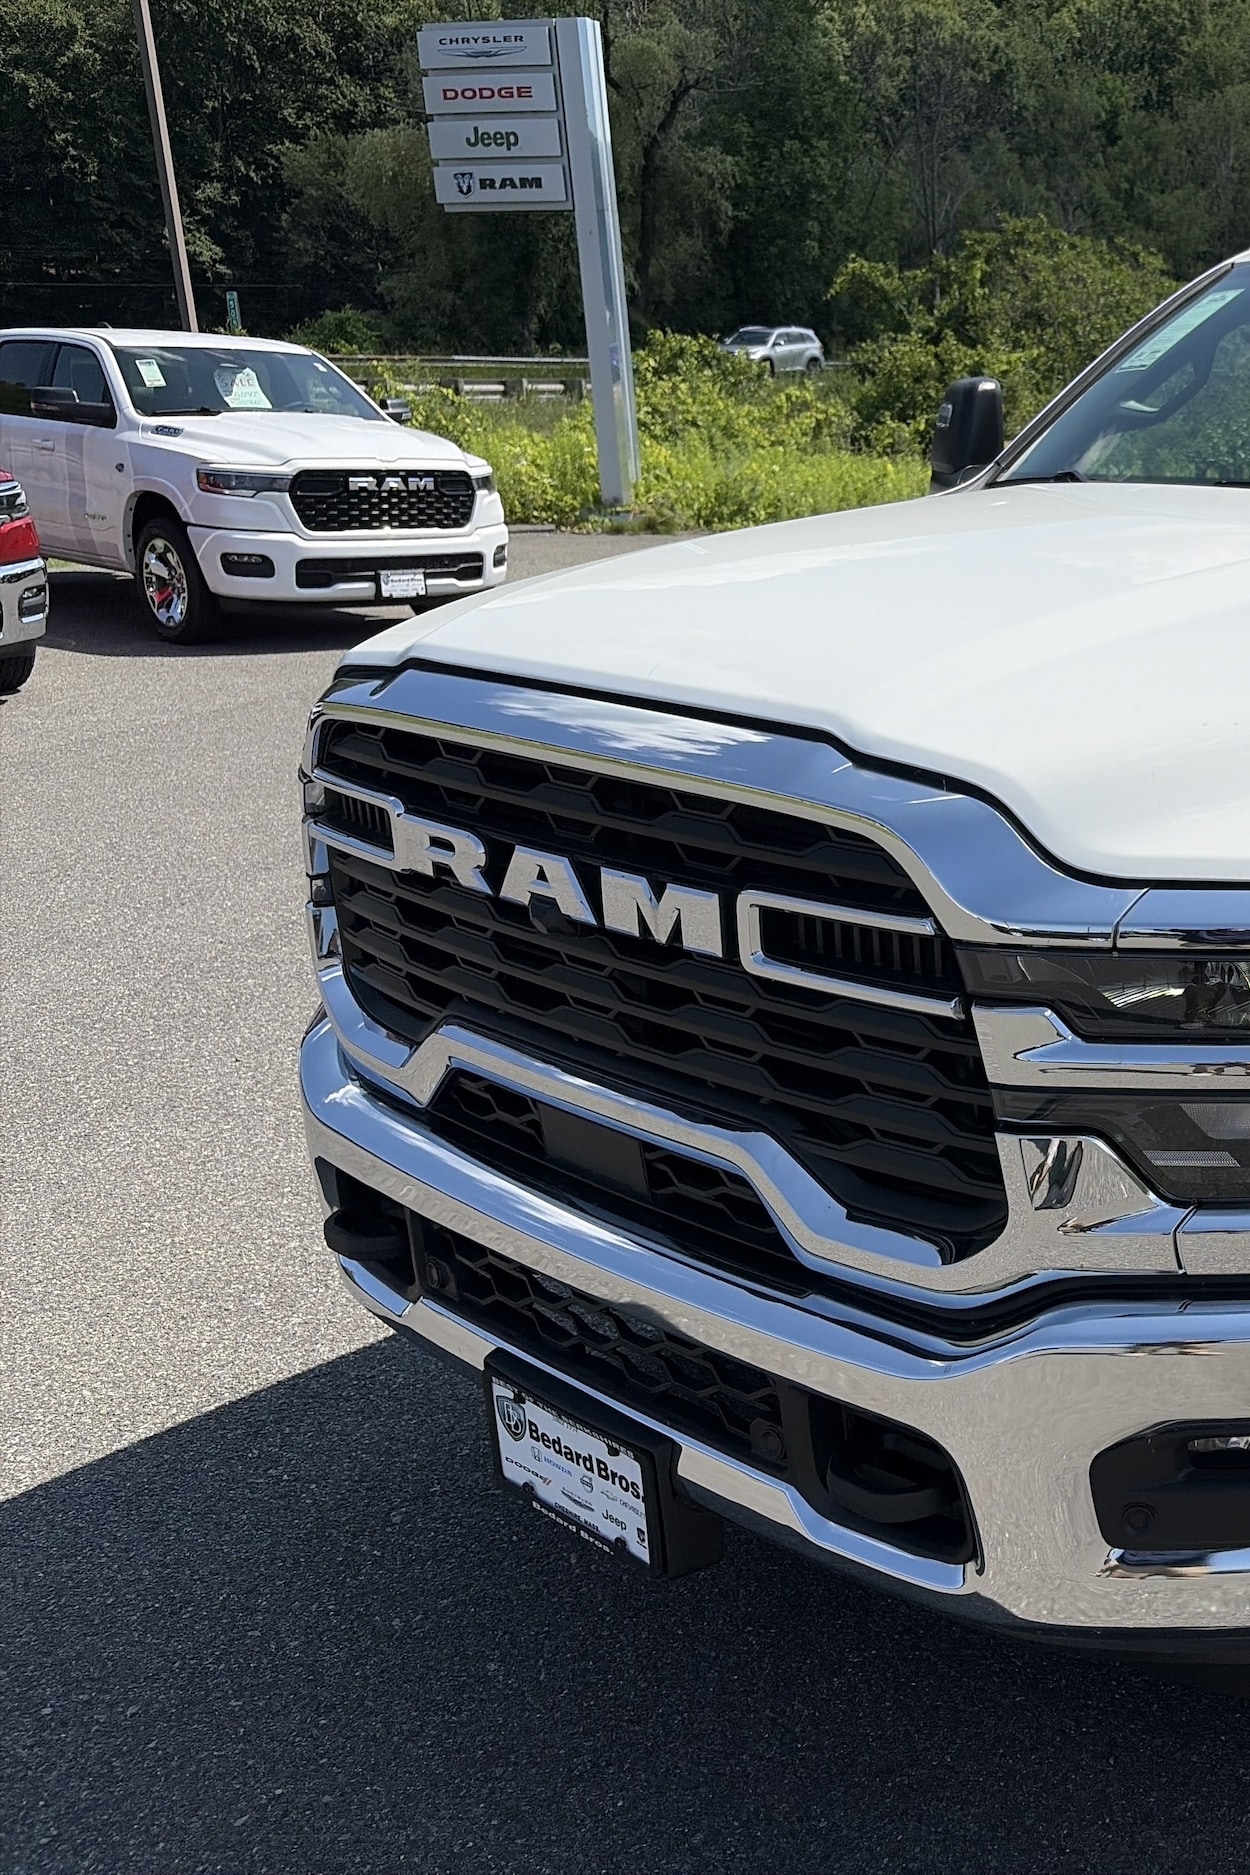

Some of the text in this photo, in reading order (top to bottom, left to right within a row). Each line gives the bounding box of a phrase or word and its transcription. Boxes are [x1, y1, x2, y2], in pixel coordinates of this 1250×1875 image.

[438, 34, 525, 46] CHRYSLER
[442, 86, 533, 101] DODGE
[465, 126, 520, 151] Jeep
[479, 176, 543, 190] RAM
[348, 477, 435, 491] RAM
[398, 811, 725, 959] RAM
[527, 1418, 645, 1503] Bedard Bros.
[543, 1455, 573, 1477] HONDA
[532, 1500, 615, 1556] Bedard Bros.
[602, 1508, 627, 1531] Jeep
